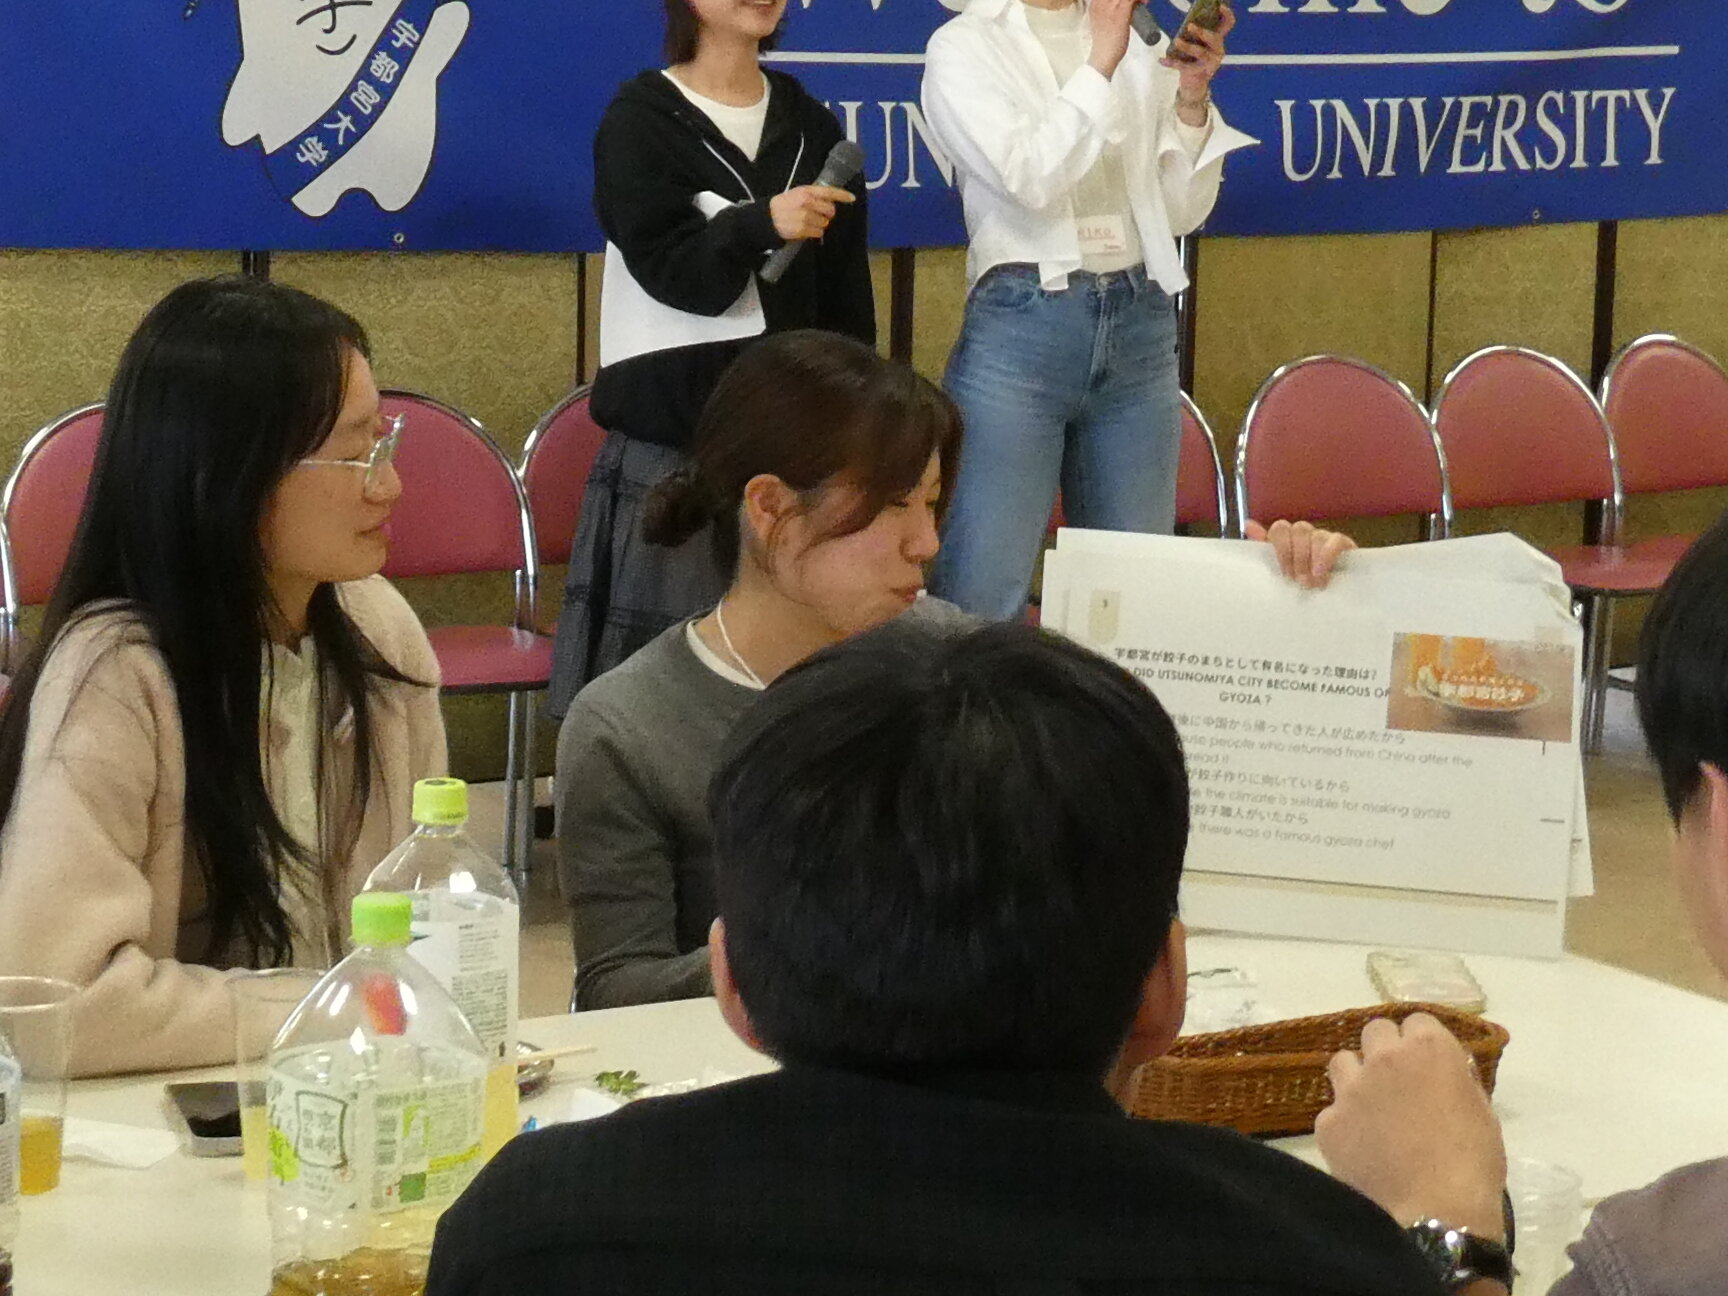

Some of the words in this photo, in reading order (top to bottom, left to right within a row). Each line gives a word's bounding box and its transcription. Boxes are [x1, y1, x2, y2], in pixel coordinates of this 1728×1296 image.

[294, 18, 421, 167] 宇都宮大学
[1273, 86, 1677, 183] UNIVERSITY
[1158, 669, 1234, 685] UTSUNOMIYA
[1237, 675, 1263, 688] CITY
[1267, 678, 1318, 693] BECOME
[1320, 682, 1371, 698] FAMOUS
[1219, 691, 1261, 705] GYOZA
